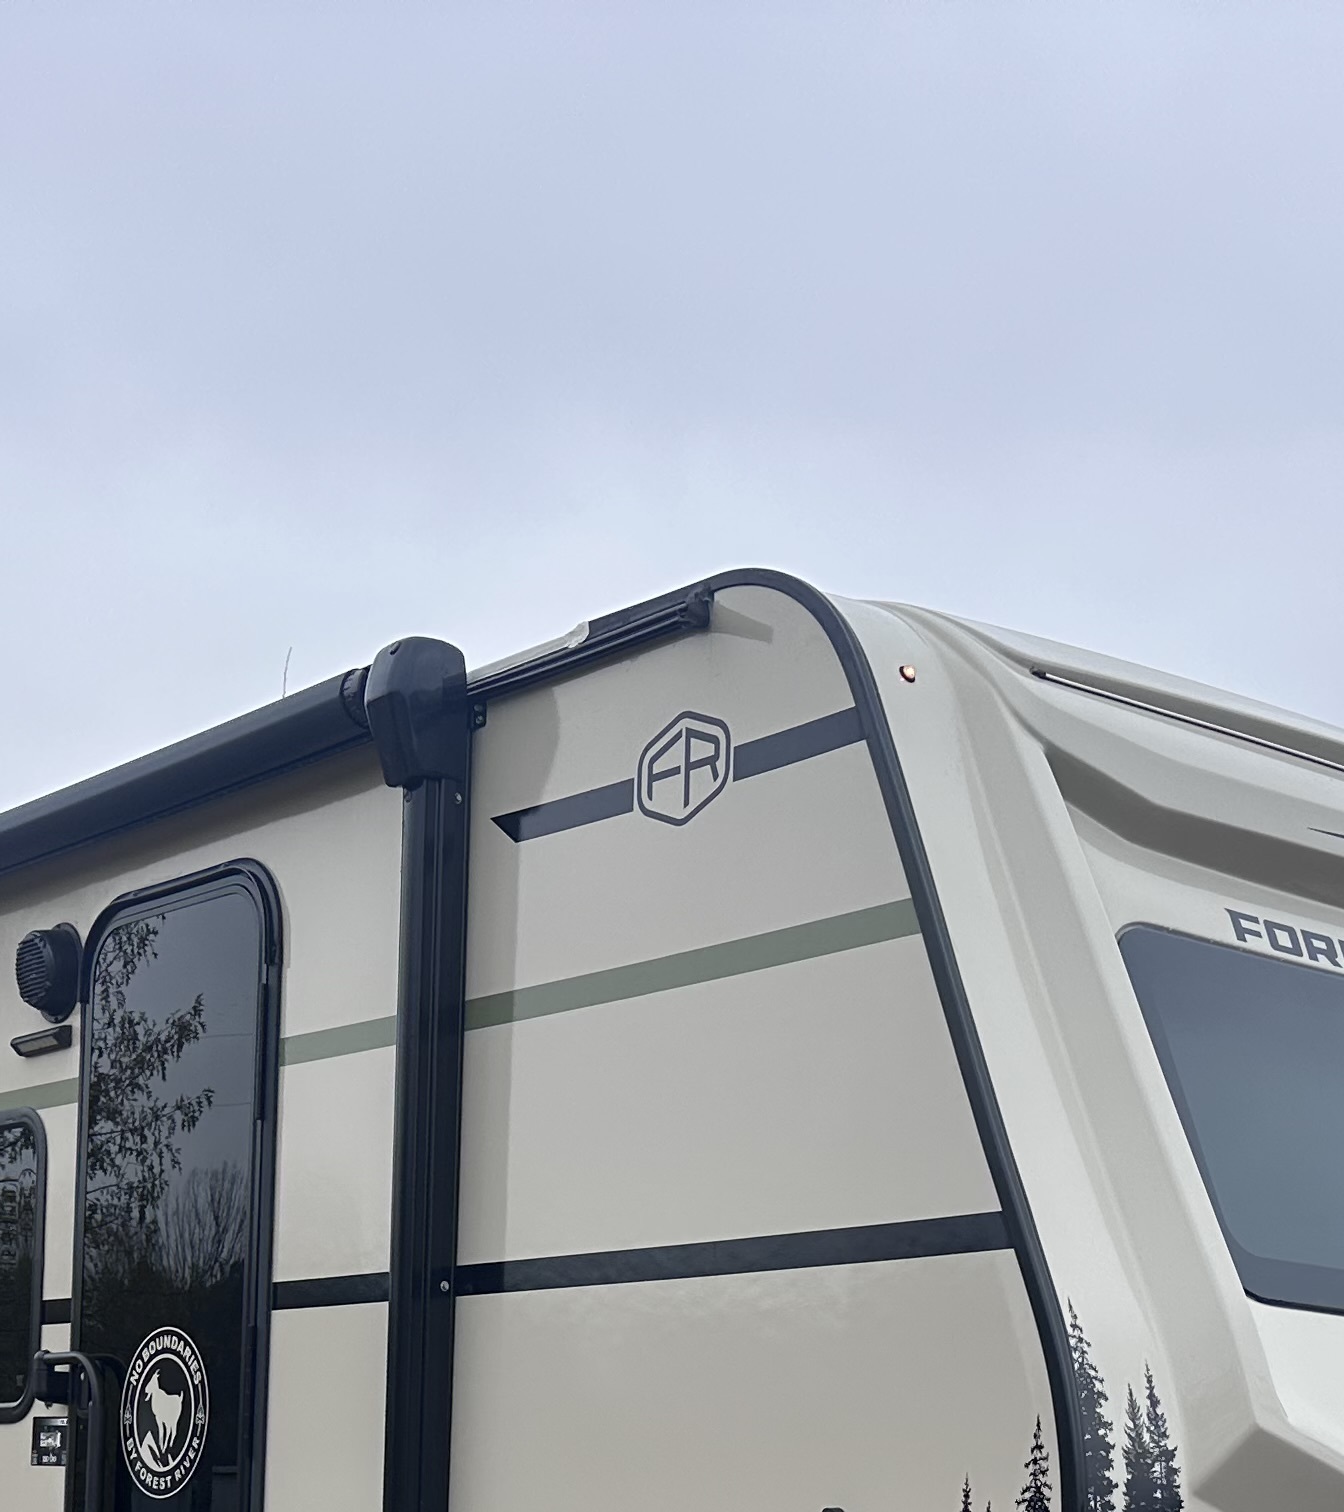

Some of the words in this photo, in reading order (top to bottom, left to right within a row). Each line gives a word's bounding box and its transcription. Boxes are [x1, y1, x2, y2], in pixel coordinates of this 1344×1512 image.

[646, 725, 720, 809] FR
[129, 1360, 144, 1387] NO
[142, 1333, 202, 1386] BOUNDARIES
[125, 1438, 138, 1461] BY
[134, 1461, 173, 1491] FOREST
[173, 1437, 201, 1482] RIVER
